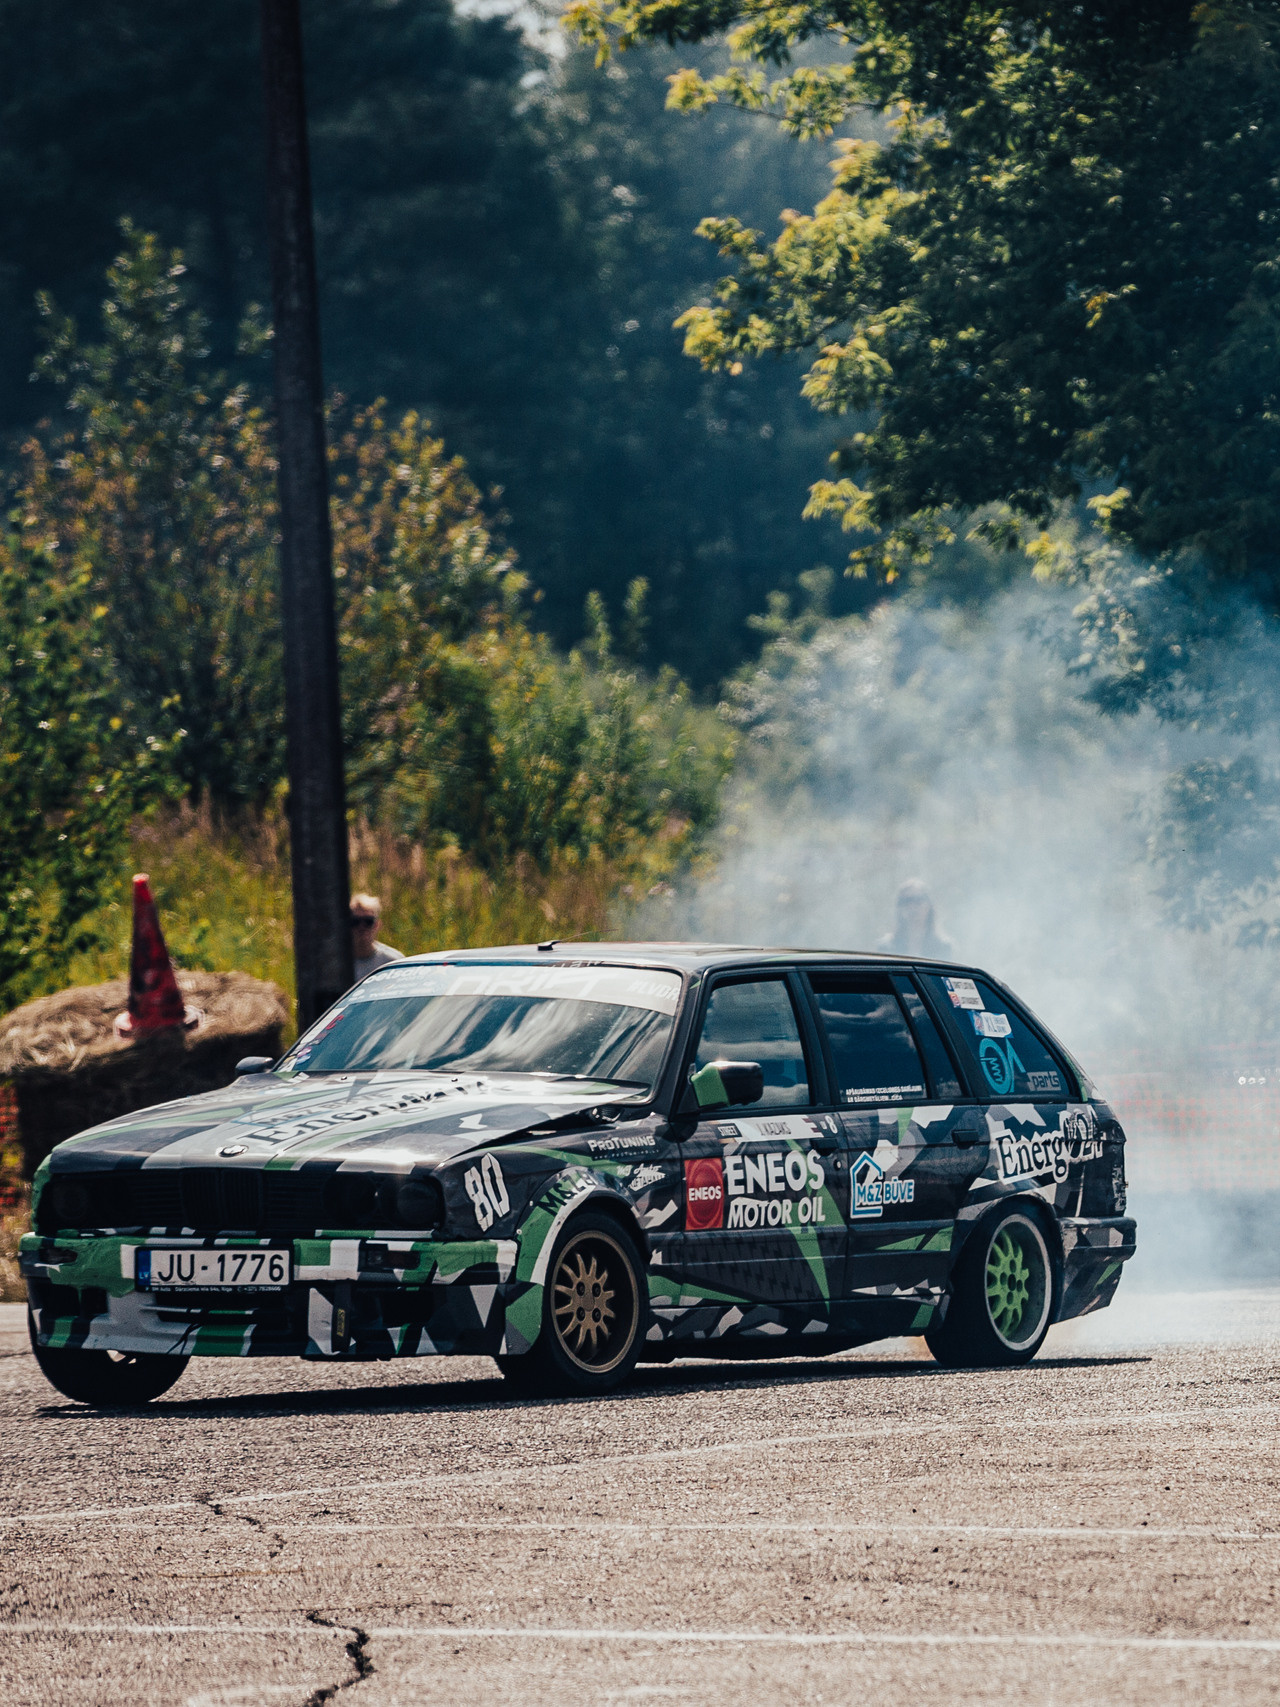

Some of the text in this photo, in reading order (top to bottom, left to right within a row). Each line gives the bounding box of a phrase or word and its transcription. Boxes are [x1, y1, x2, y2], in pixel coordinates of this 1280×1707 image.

[1031, 1073, 1060, 1089] parts
[726, 1149, 825, 1196] ENEOS
[464, 1152, 510, 1232] 80
[688, 1185, 722, 1202] ENEOS
[856, 1180, 883, 1206] M&Z
[727, 1196, 826, 1229] MOTOR OIL
[138, 1271, 150, 1280] LV
